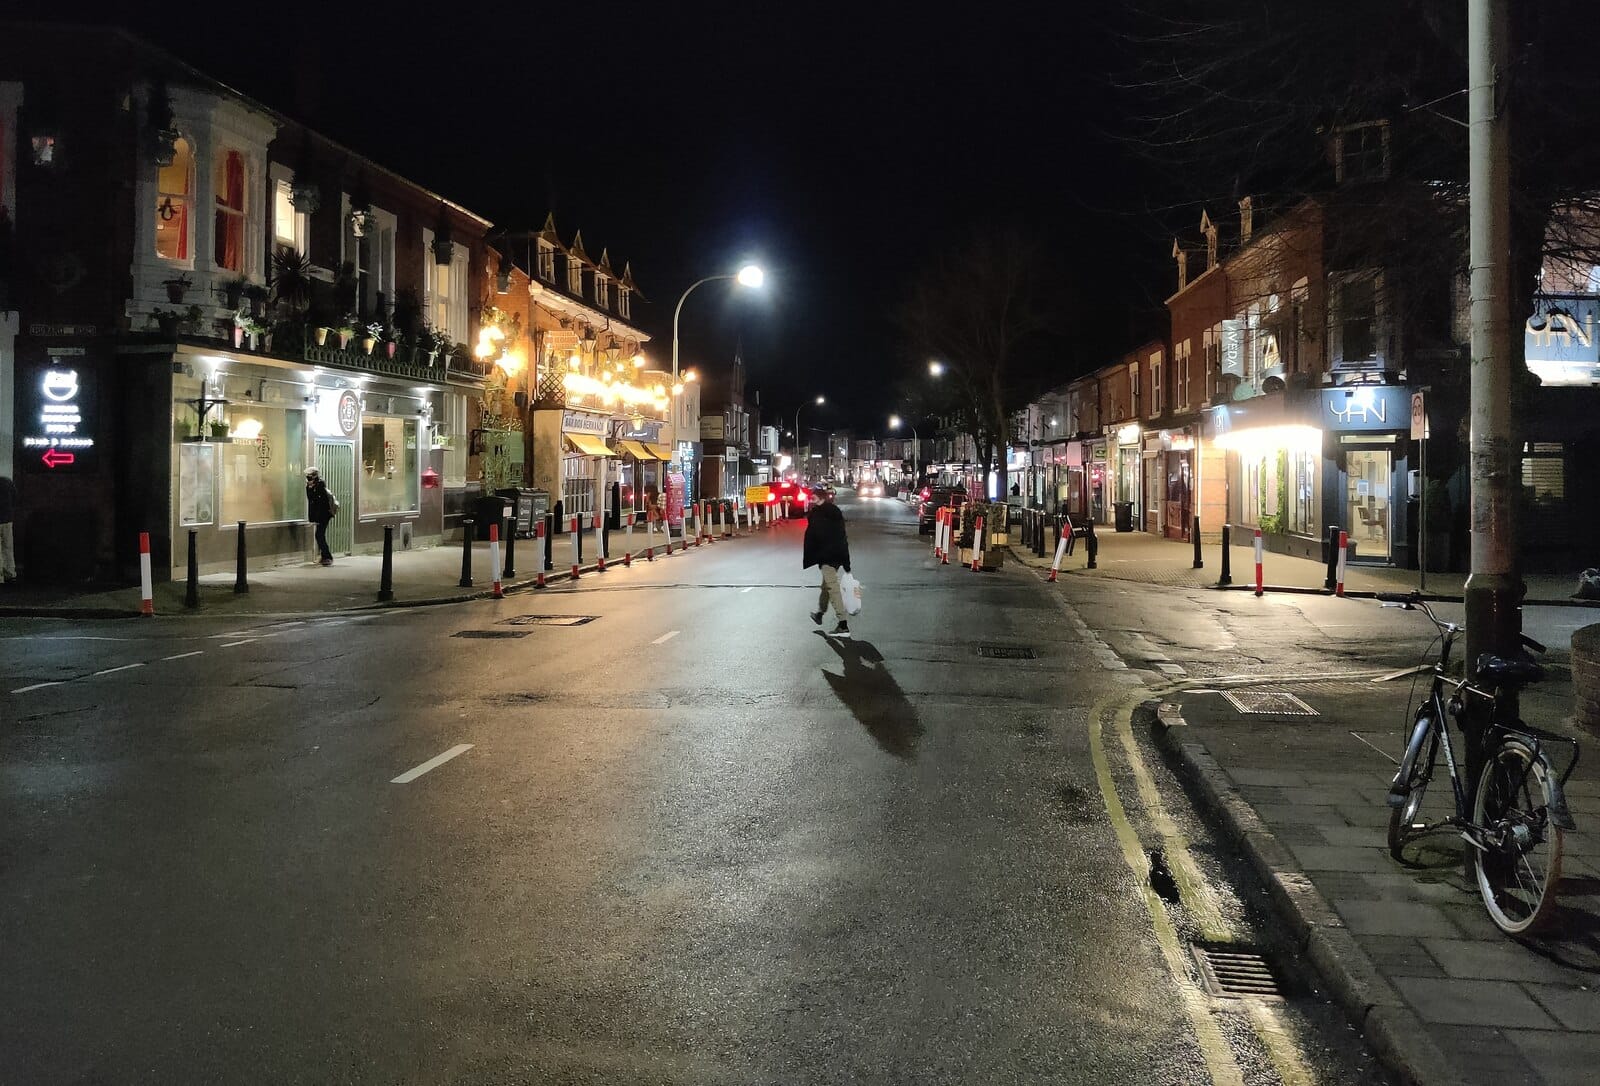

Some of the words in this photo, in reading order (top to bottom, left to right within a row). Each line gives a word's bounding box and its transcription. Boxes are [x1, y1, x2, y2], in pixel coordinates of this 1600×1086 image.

[1227, 326, 1238, 369] AVEDA
[1329, 398, 1387, 424] YAN
[1413, 403, 1422, 417] 20
